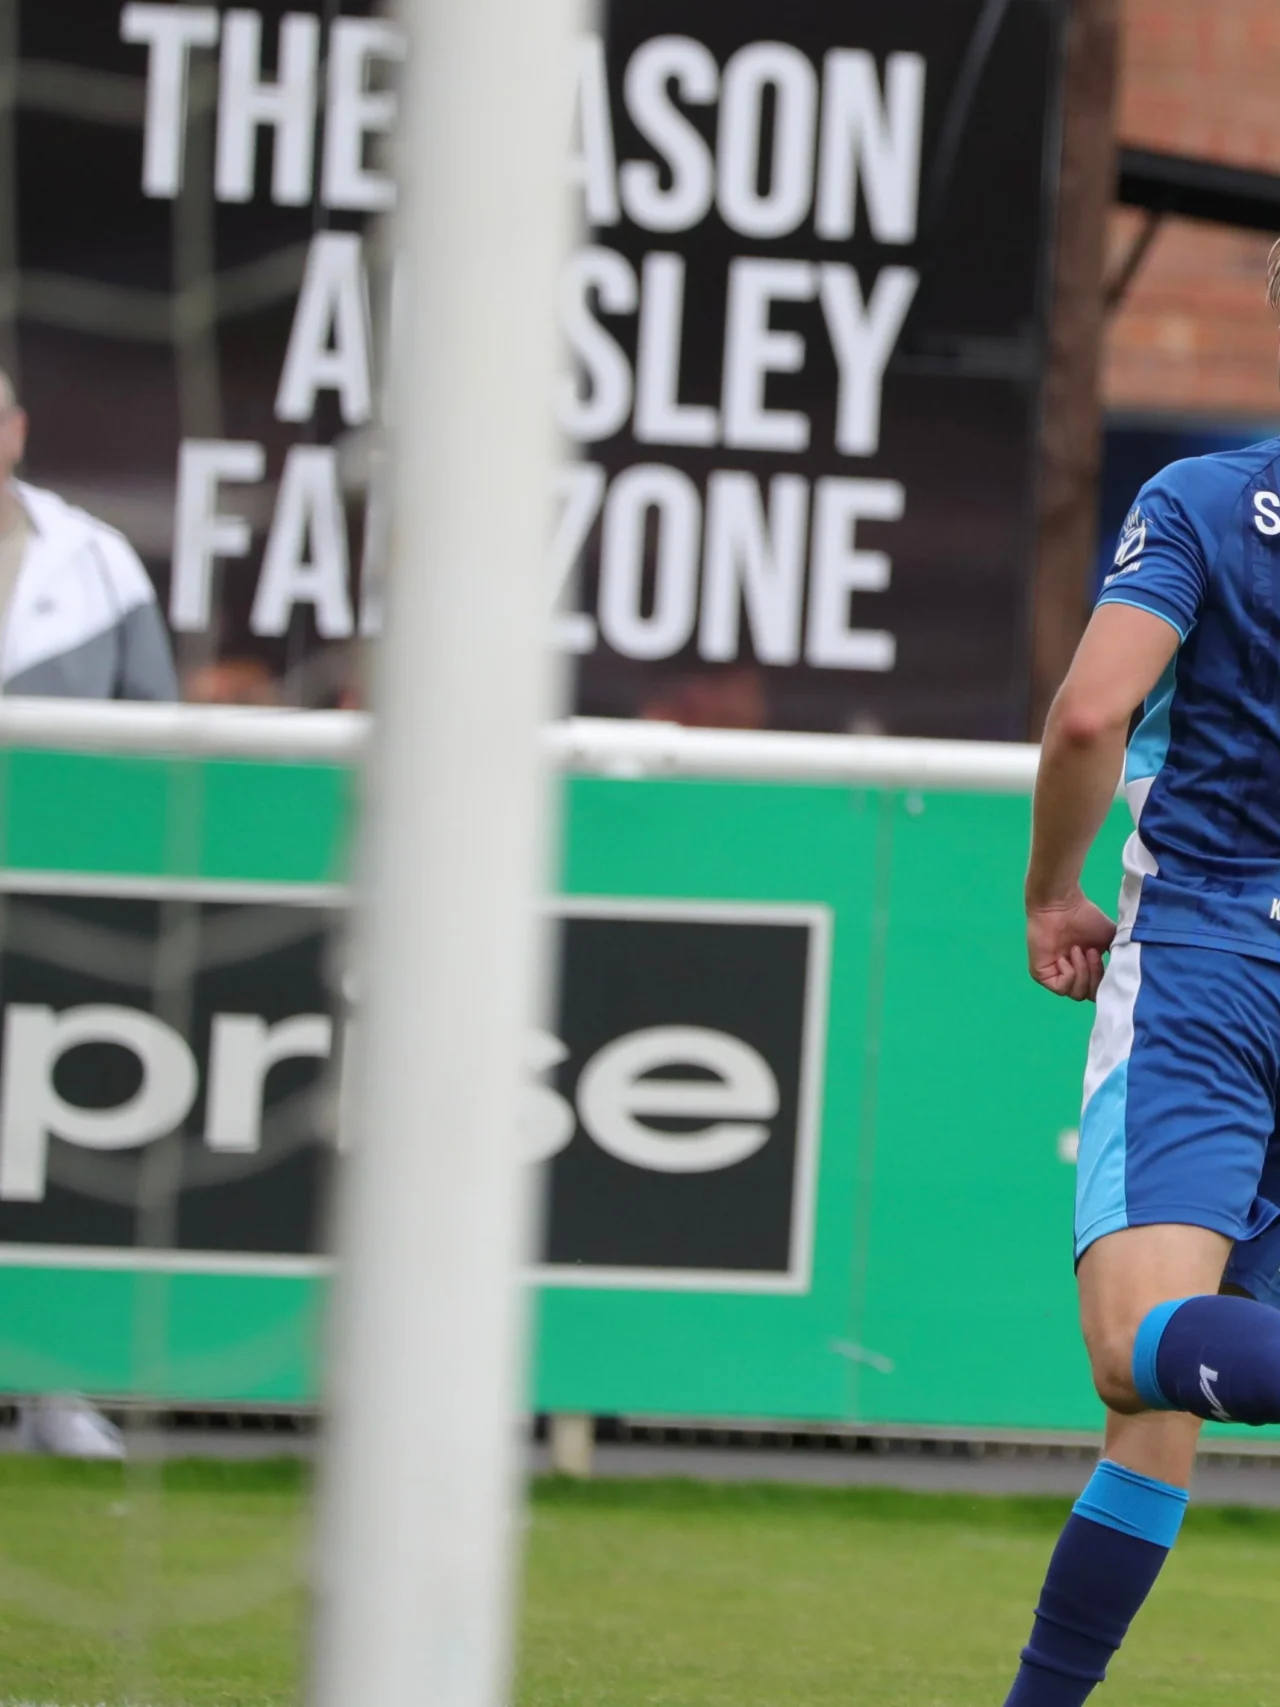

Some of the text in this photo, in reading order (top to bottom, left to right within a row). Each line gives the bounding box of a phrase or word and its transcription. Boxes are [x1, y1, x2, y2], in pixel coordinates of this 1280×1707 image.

[120, 3, 927, 245] THE ASON
[275, 230, 919, 457] ASLEY
[170, 438, 906, 672] FA ZONE
